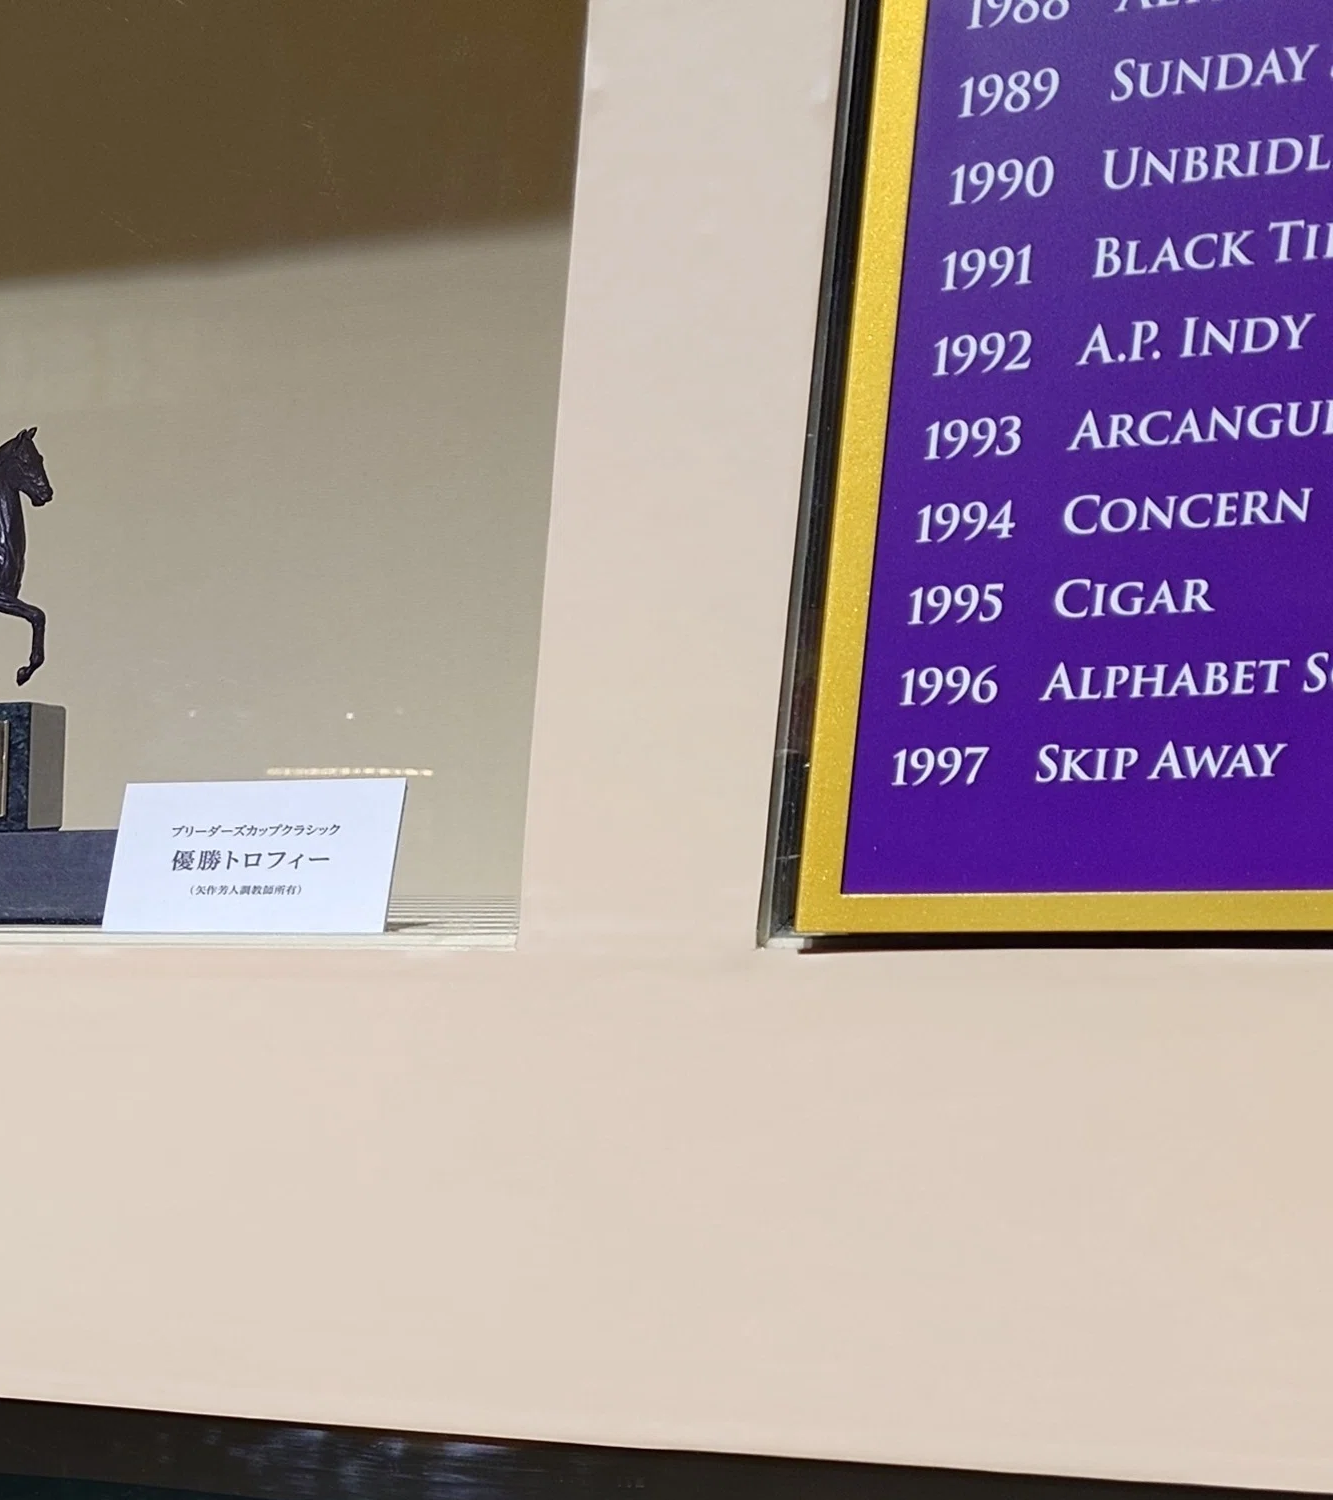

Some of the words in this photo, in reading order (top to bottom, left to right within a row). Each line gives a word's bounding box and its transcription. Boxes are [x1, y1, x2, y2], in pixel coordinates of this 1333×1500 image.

[958, 66, 1060, 119] 1989
[1109, 44, 1320, 101] SUNDAY
[949, 155, 1054, 206] 1990
[940, 244, 1033, 291] 1991
[1092, 229, 1255, 278] BLACK
[932, 330, 1032, 377] 1992
[1076, 320, 1161, 366] A.P.
[1179, 312, 1316, 358] INDY
[923, 415, 1022, 461] 1993
[915, 500, 1016, 543] 1994
[1062, 487, 1313, 536] CONCERN
[907, 582, 1004, 626] 1995
[1053, 578, 1215, 619] CIGAR
[899, 665, 999, 707] 1996
[1039, 658, 1290, 703] ALPHABET
[890, 746, 989, 787] 1997
[1035, 744, 1139, 784] SKIP
[1147, 741, 1287, 781] AWAY
[172, 824, 341, 837] ブリーダーズカップクラシック
[171, 849, 330, 871] 優勝トロフィー
